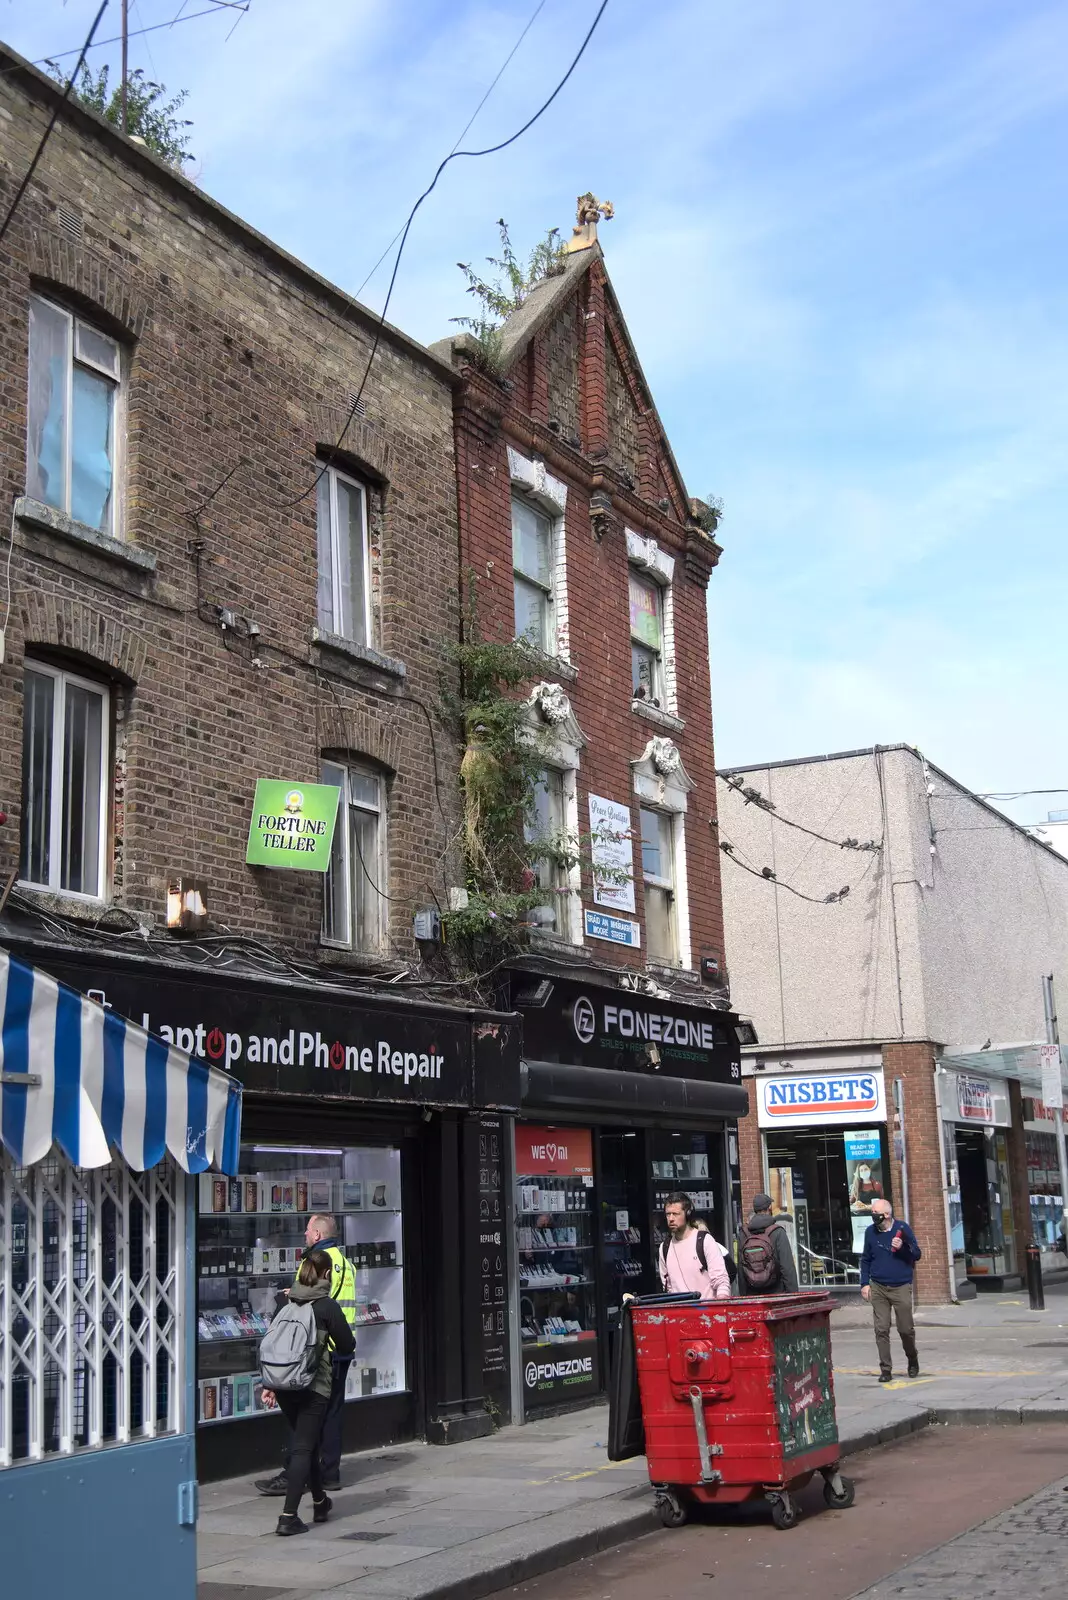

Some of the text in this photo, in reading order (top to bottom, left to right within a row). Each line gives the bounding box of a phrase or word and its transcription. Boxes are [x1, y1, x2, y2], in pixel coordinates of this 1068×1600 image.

[258, 815, 326, 835] FORTUNE
[263, 833, 316, 852] TELLER
[592, 925, 626, 941] MOORE STREET
[604, 1005, 714, 1049] FONEZONE
[247, 1029, 295, 1065] and
[299, 1032, 373, 1072] Phone
[378, 1041, 445, 1085] Repair
[769, 1078, 874, 1105] NISBETS
[531, 1145, 546, 1159] WE
[538, 1357, 592, 1380] FONEZONE
